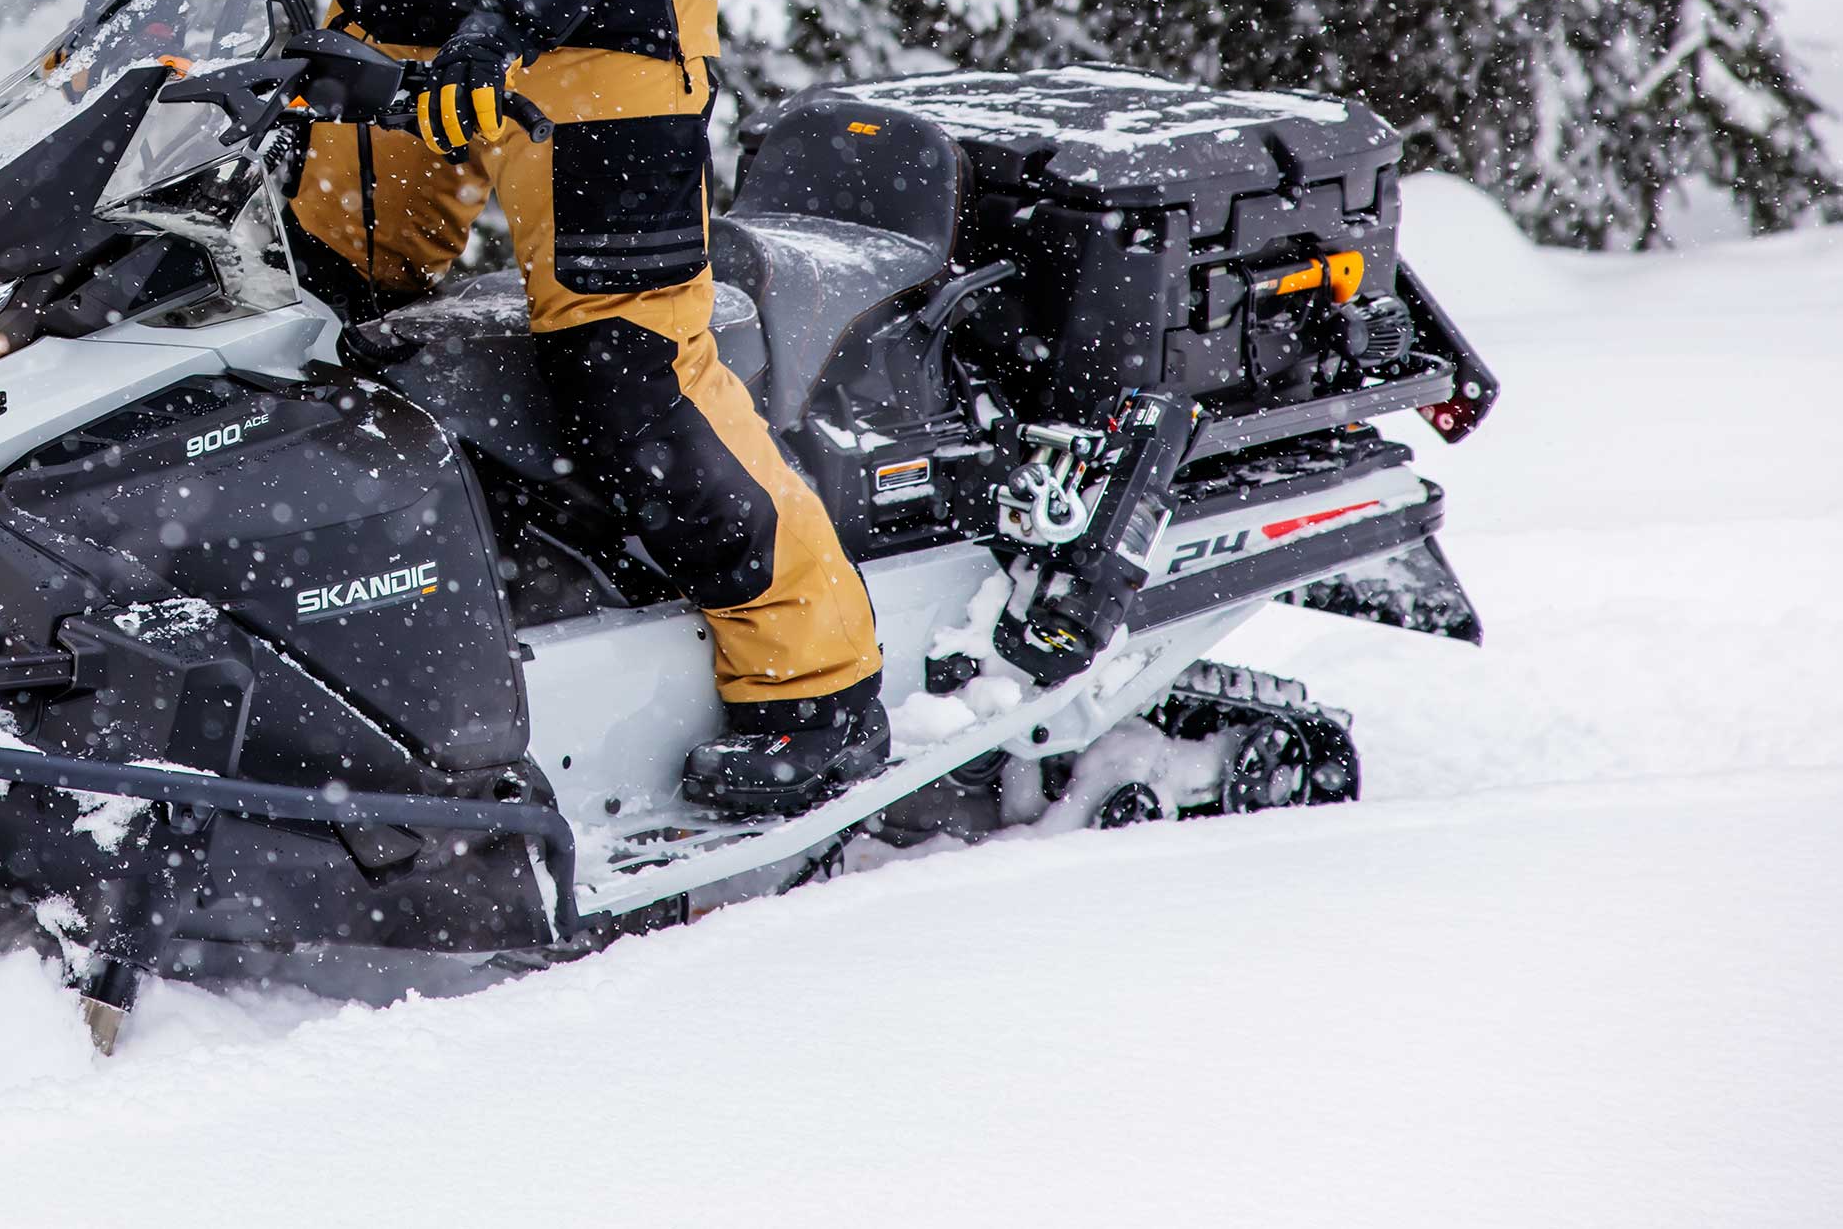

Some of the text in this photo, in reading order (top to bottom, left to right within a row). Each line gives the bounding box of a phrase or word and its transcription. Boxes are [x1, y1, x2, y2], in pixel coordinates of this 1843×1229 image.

[847, 122, 881, 136] SE
[186, 413, 269, 458] 900 ACE
[1167, 529, 1251, 575] 24
[297, 561, 438, 614] SKANDIC
